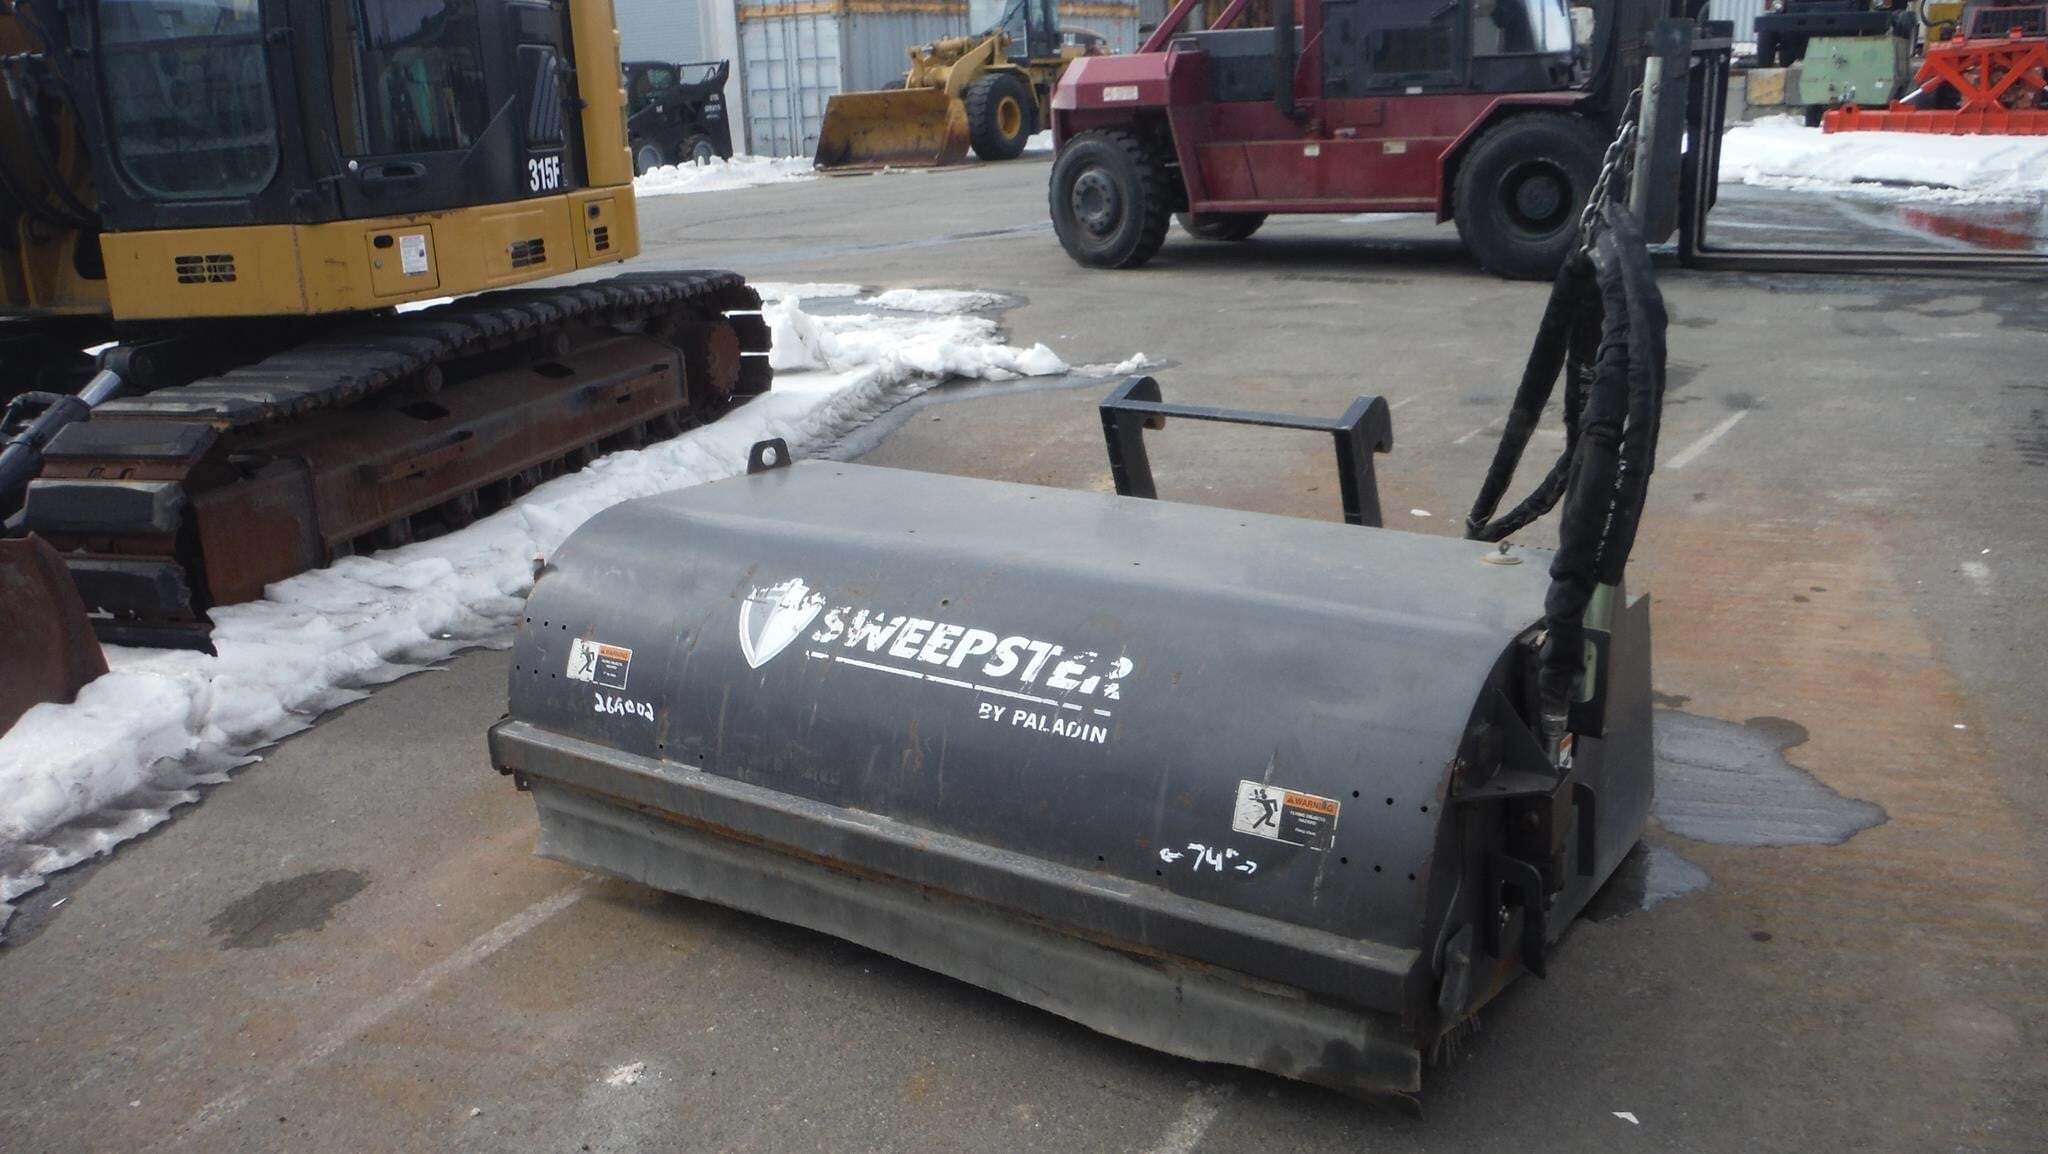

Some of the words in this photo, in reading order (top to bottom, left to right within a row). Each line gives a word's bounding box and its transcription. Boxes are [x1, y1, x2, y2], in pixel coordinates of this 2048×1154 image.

[528, 156, 560, 191] 315F
[811, 606, 1133, 700] SWEEPSTER
[978, 702, 1006, 722] BY
[1012, 709, 1108, 744] PALADIN
